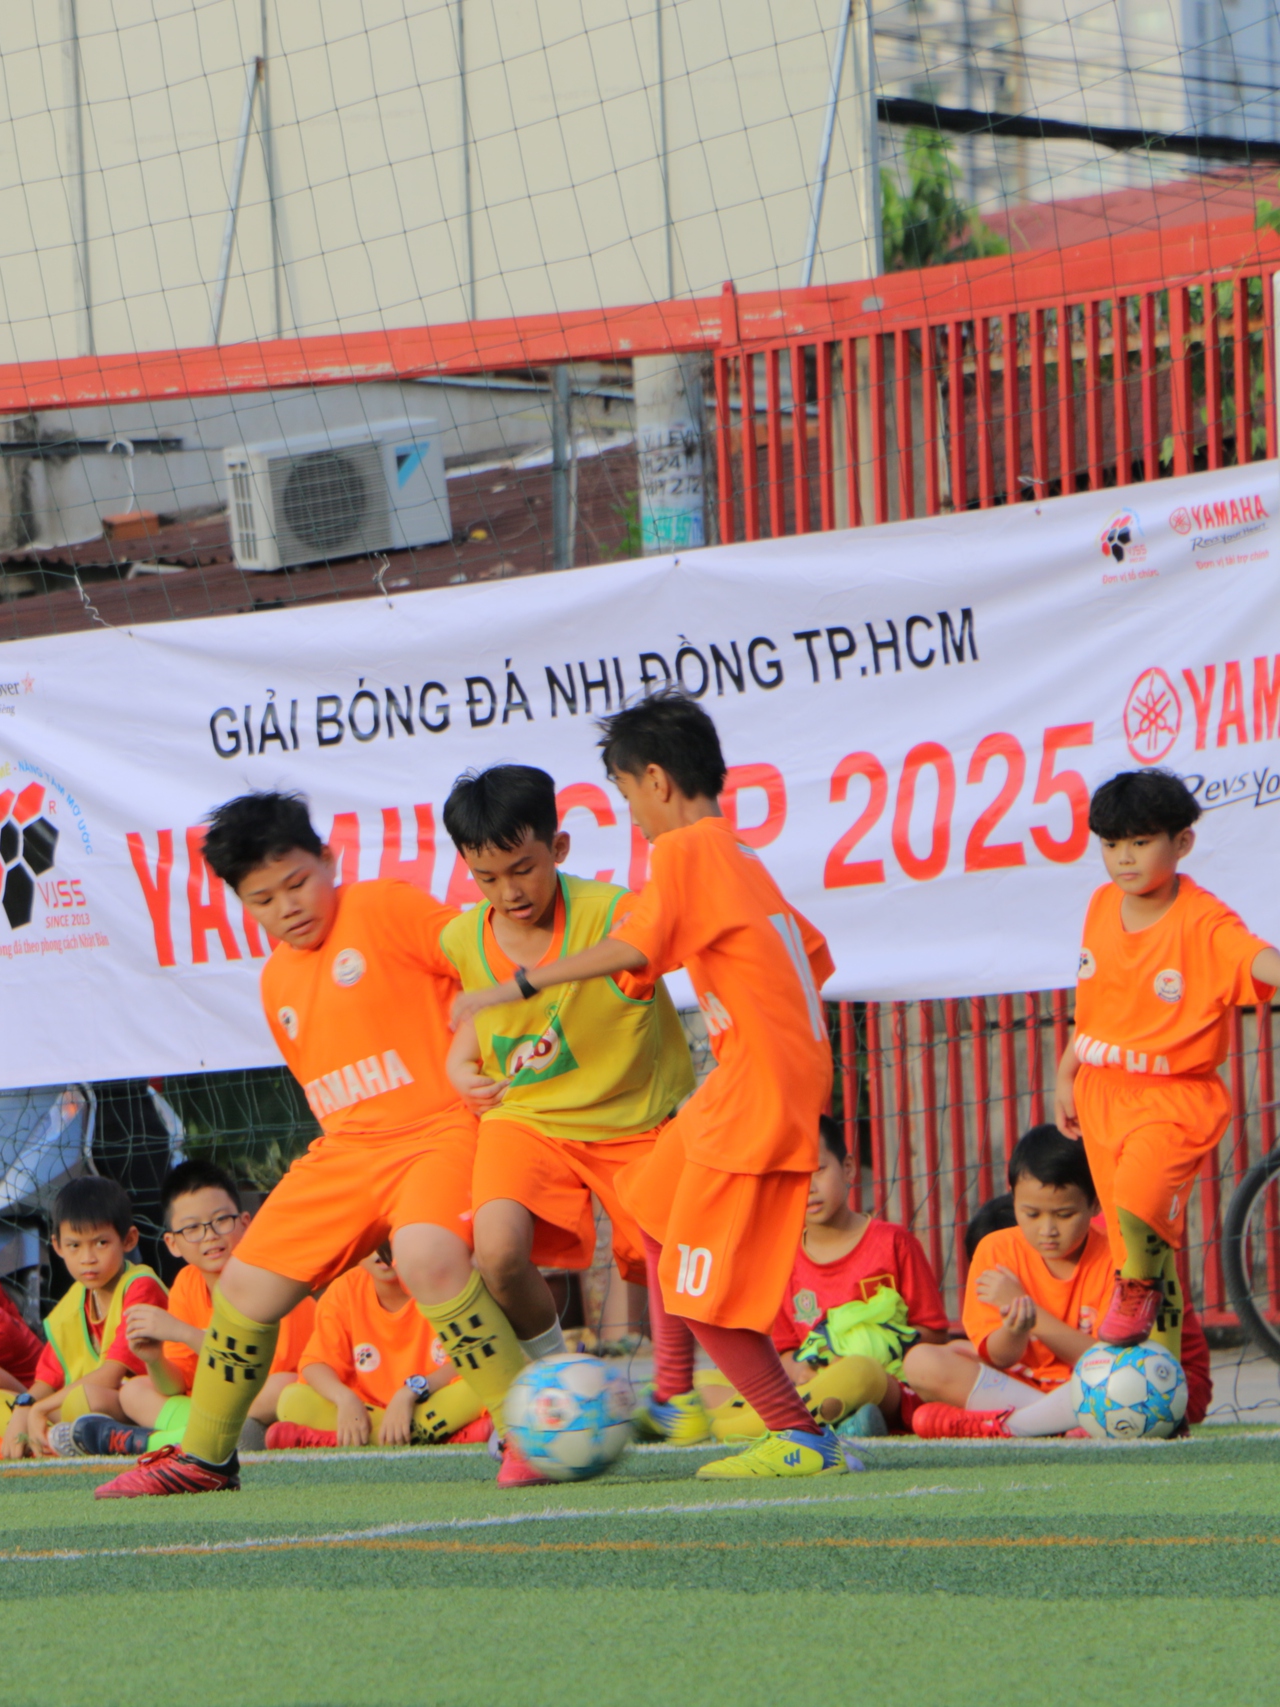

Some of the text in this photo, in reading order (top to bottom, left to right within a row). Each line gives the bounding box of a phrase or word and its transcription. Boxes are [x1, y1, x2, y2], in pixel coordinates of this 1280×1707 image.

[1191, 494, 1270, 531] YAMAHA
[209, 607, 979, 759] GIẢI BÓNG ĐÁ NHI ĐỒNG TP.HCM
[824, 721, 1094, 890] 2025
[45, 913, 91, 929] SINCE 2013
[24, 938, 40, 954] theo
[675, 1243, 713, 1298] 10
